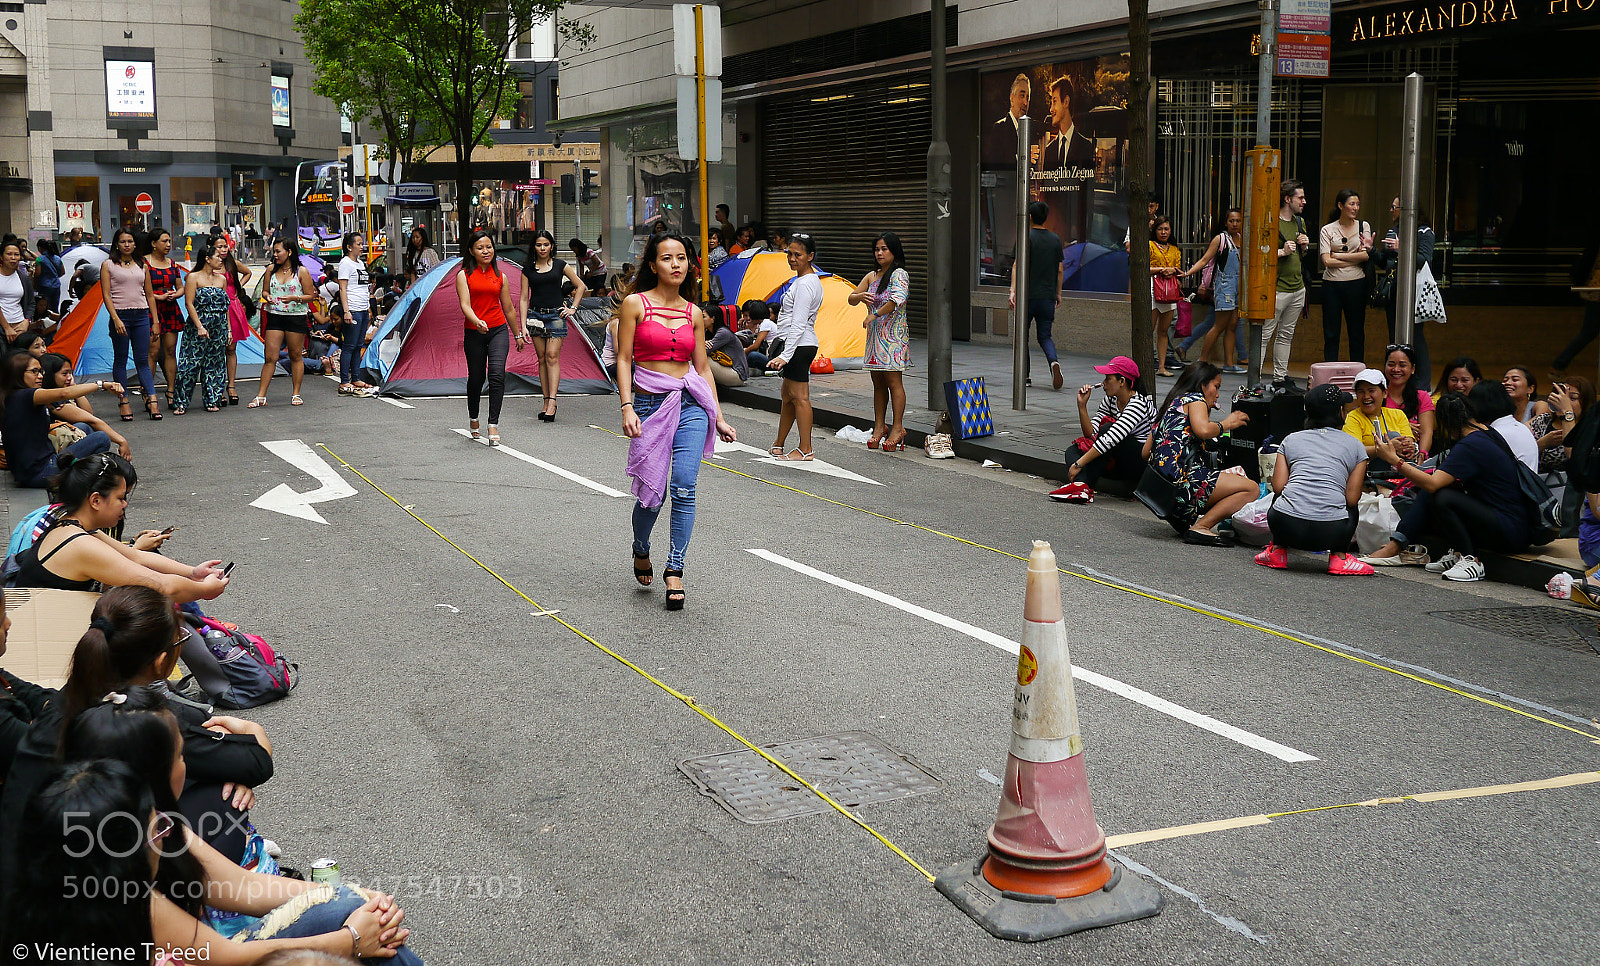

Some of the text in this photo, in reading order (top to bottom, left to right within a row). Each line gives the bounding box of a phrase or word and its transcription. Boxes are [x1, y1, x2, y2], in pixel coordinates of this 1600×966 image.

[1352, 0, 1518, 41] ALEXANDRA
[1280, 60, 1293, 73] 13
[1071, 165, 1095, 181] Zegna
